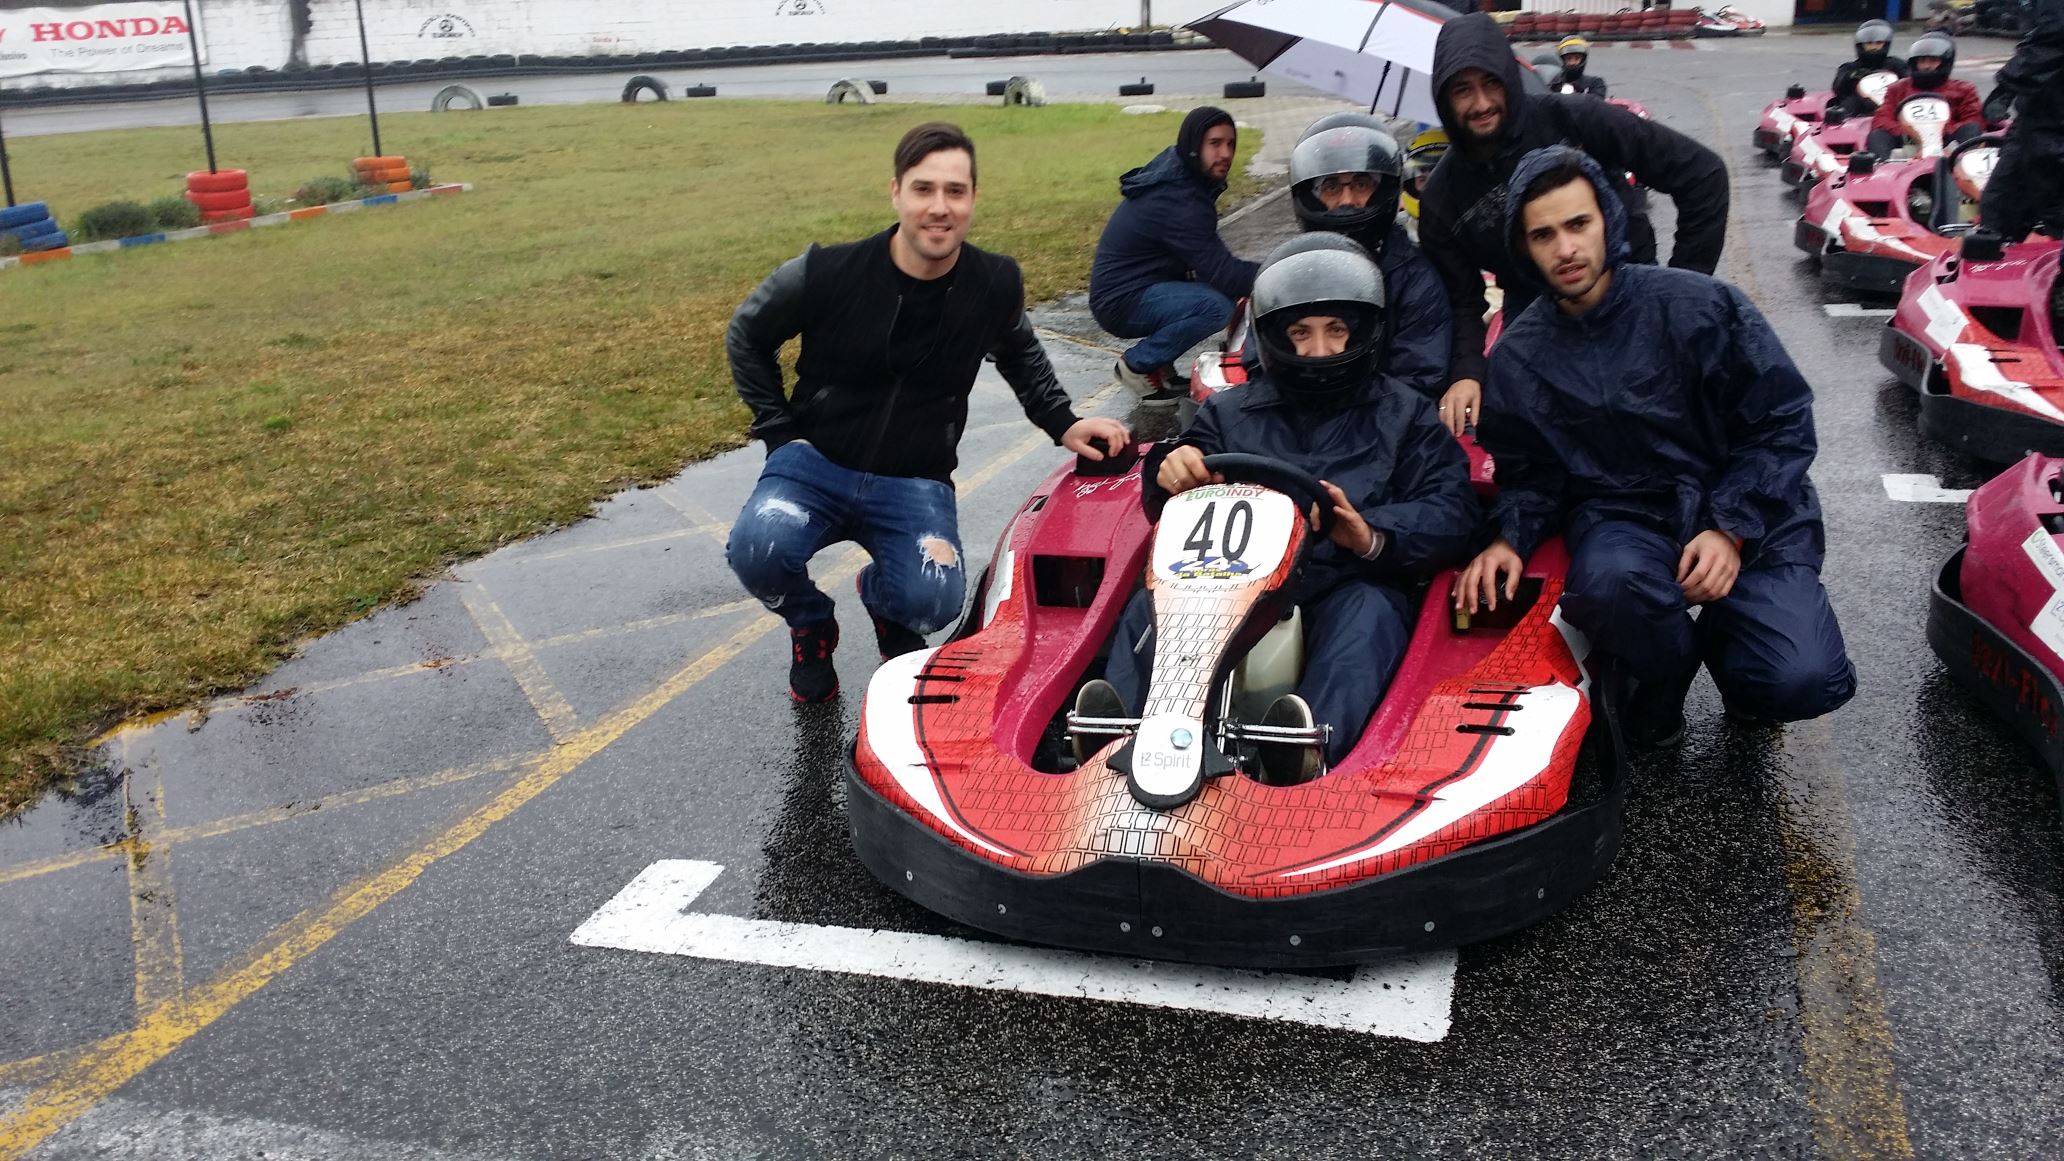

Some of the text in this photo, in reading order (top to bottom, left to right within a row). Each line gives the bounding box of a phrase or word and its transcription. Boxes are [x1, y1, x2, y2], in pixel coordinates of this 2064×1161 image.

[30, 15, 190, 42] HONDA
[49, 47, 75, 58] The
[78, 46, 118, 57] Power
[135, 43, 185, 53] Dreams
[1186, 488, 1265, 502] EUROINDY
[1183, 500, 1253, 561] 40
[1153, 751, 1192, 770] Spirit
